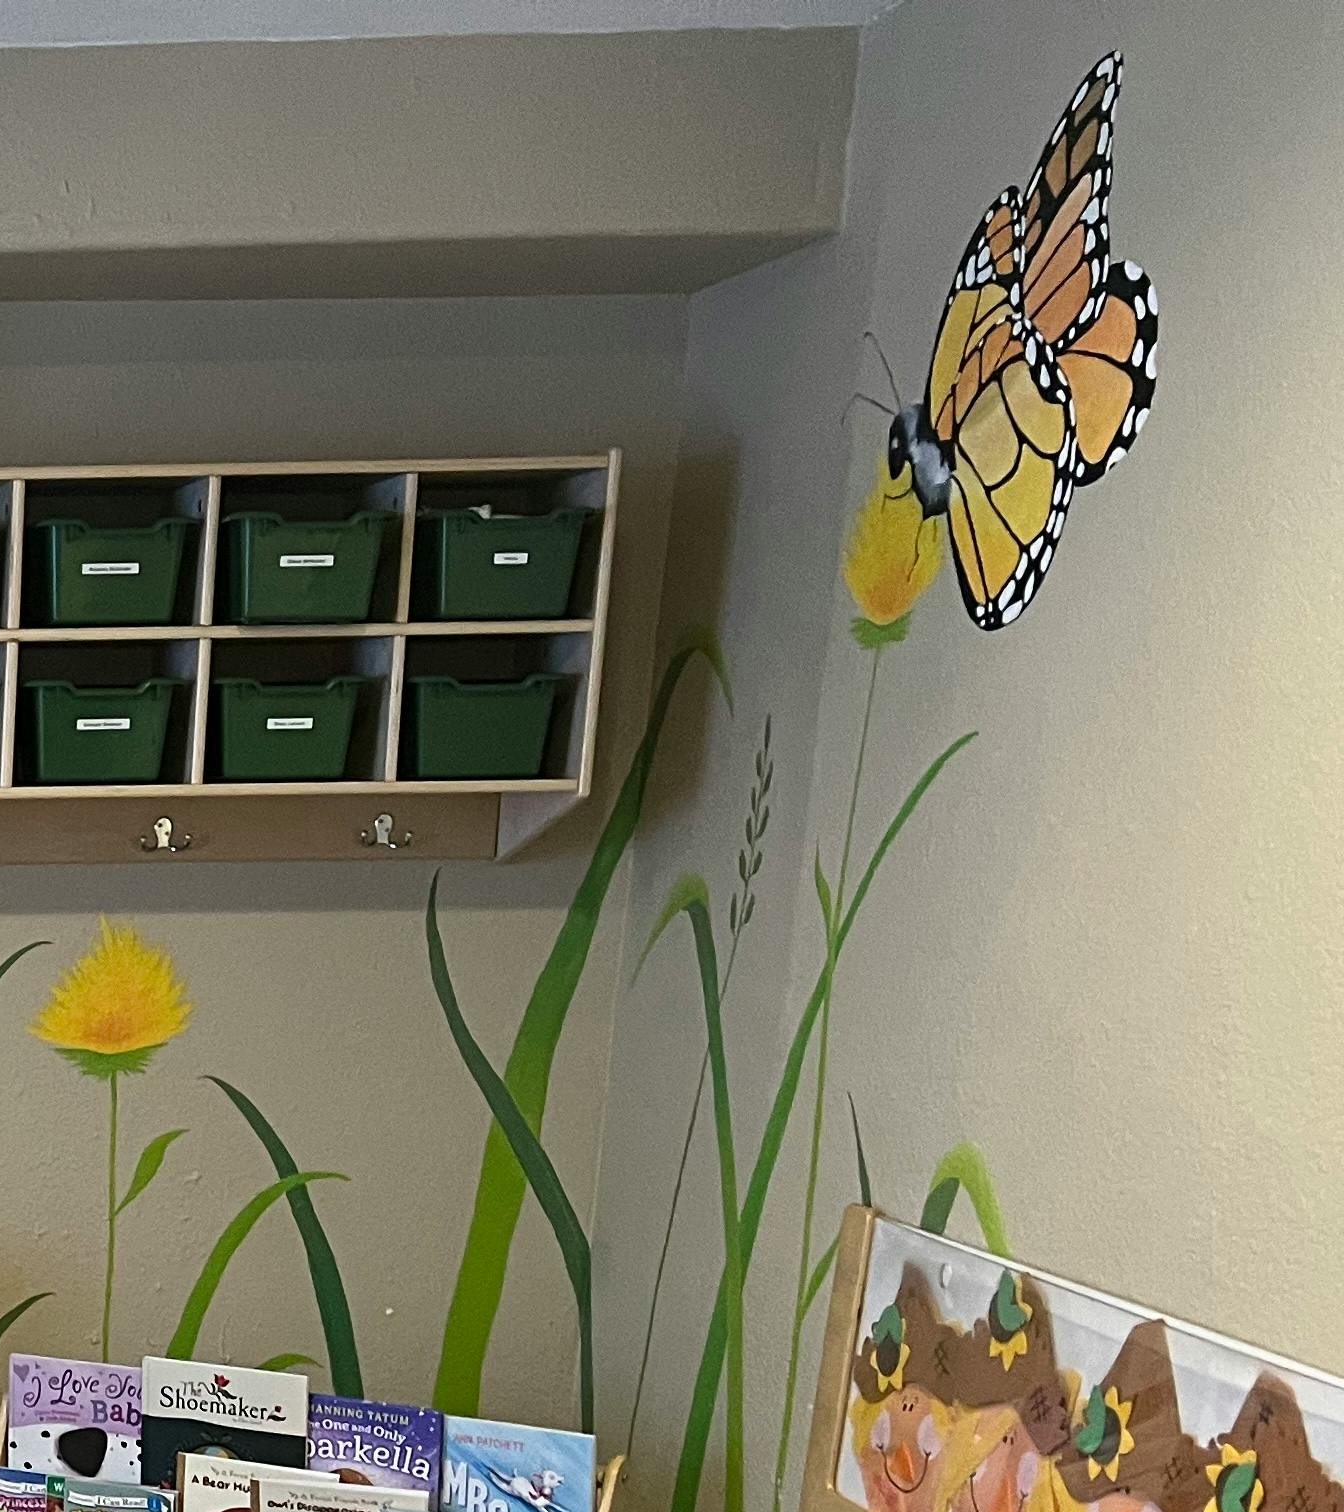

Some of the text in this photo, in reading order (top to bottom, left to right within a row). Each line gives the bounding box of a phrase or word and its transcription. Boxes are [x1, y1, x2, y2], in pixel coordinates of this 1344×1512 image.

[48, 1369, 100, 1406] Love
[159, 1386, 268, 1420] Shoemaker
[368, 1410, 410, 1425] TATUM
[322, 1419, 407, 1445] One and Only
[191, 1475, 199, 1484] A
[202, 1476, 230, 1490] Bear
